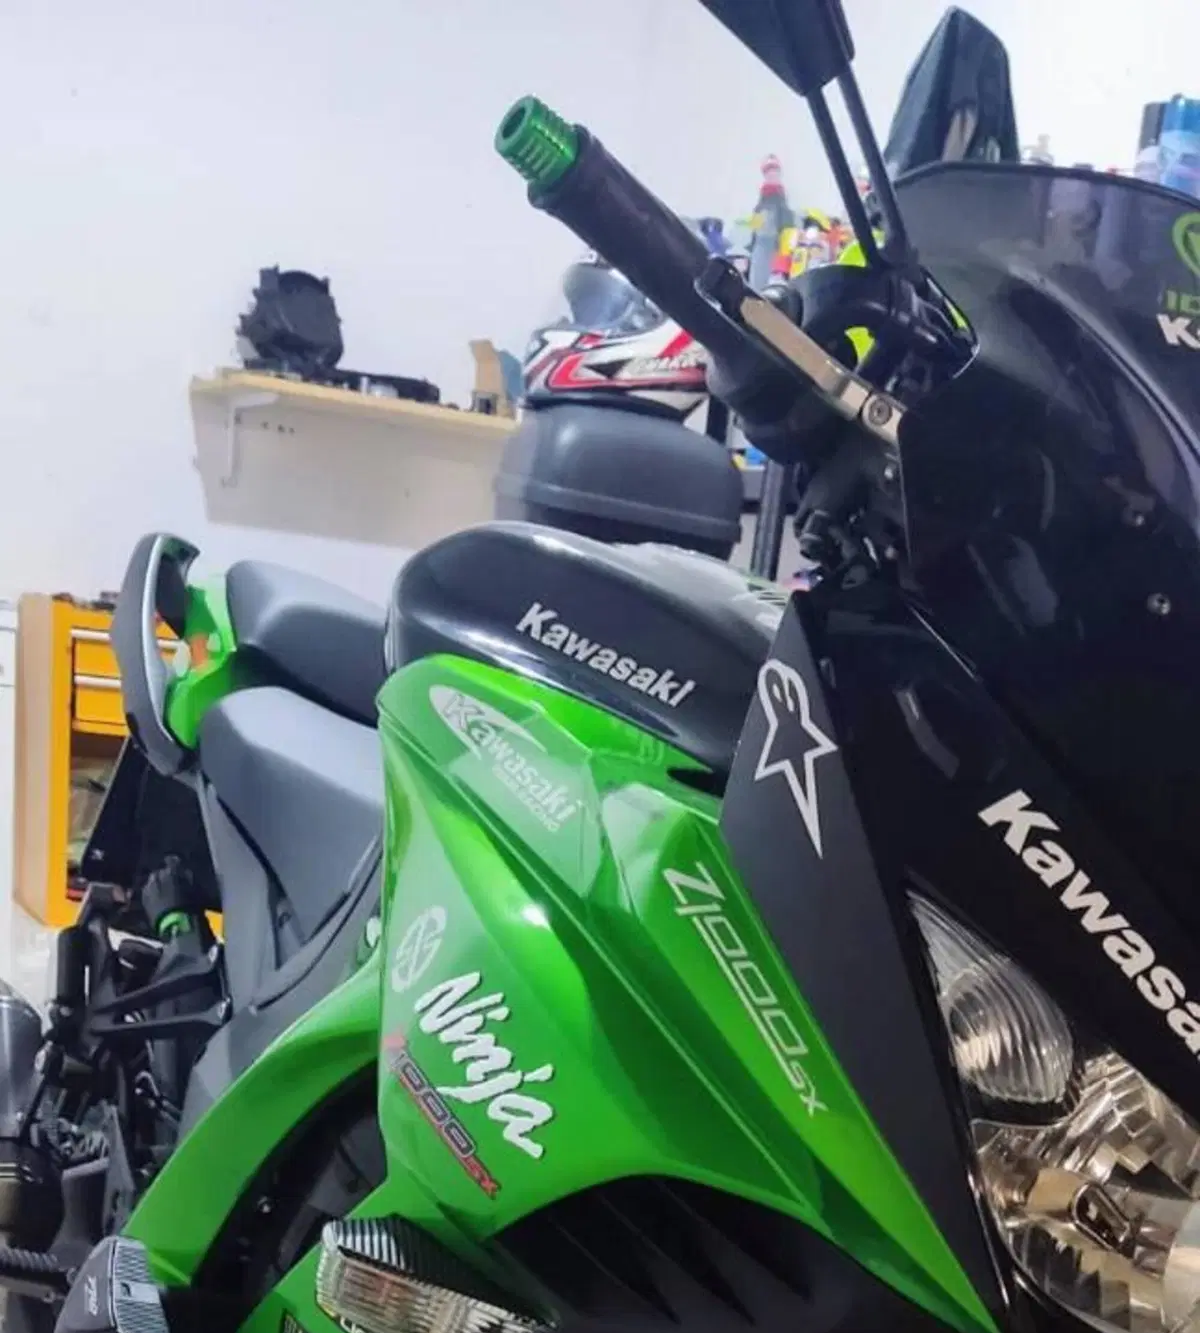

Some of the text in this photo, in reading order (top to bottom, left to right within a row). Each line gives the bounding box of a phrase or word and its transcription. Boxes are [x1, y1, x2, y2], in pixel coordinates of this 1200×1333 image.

[1156, 313, 1200, 349] K
[515, 602, 696, 708] Kawasaki
[442, 690, 578, 822] Kawasaki
[977, 788, 1200, 1060] Kawasa
[414, 971, 555, 1160] Ninja
